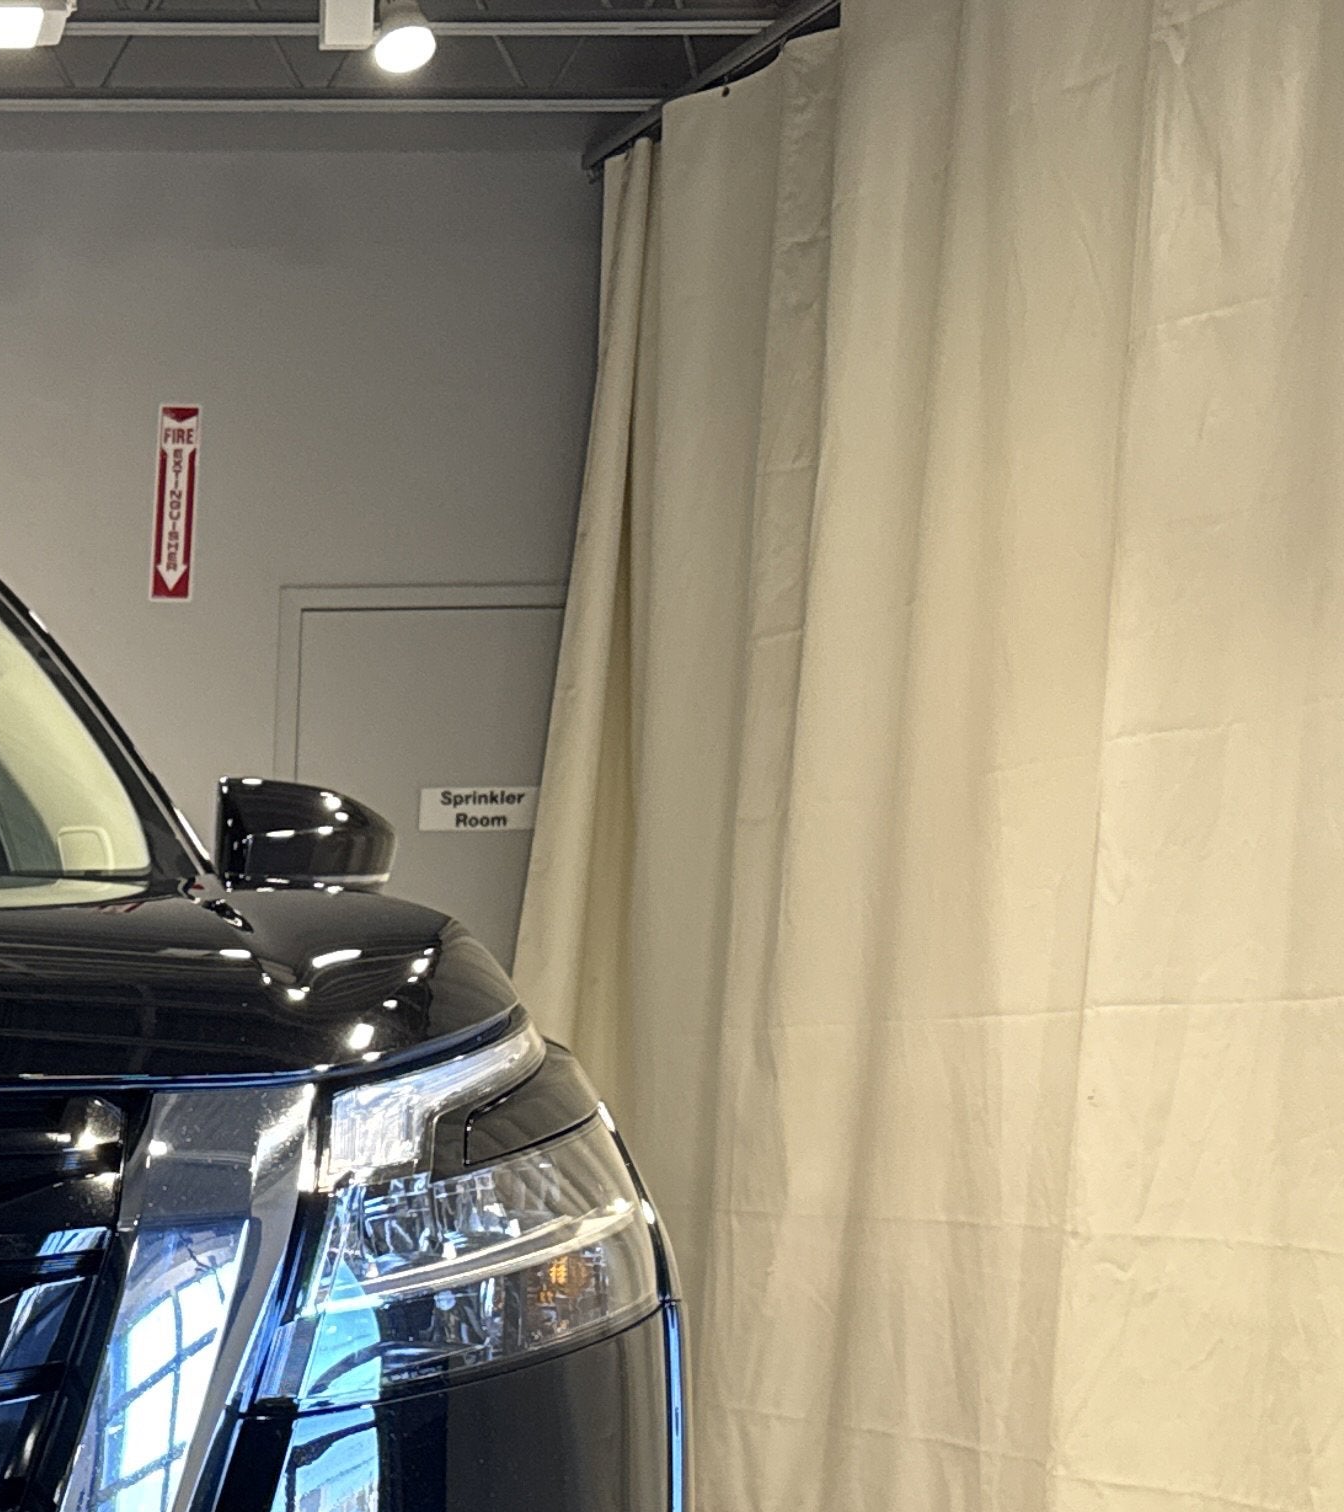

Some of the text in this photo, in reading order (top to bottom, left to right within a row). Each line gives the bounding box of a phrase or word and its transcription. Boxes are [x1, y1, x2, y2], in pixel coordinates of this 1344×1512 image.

[163, 428, 194, 444] FIRE
[166, 448, 183, 572] EXTINGUISHER
[440, 790, 525, 809] Sprinkler
[455, 813, 507, 827] Room
